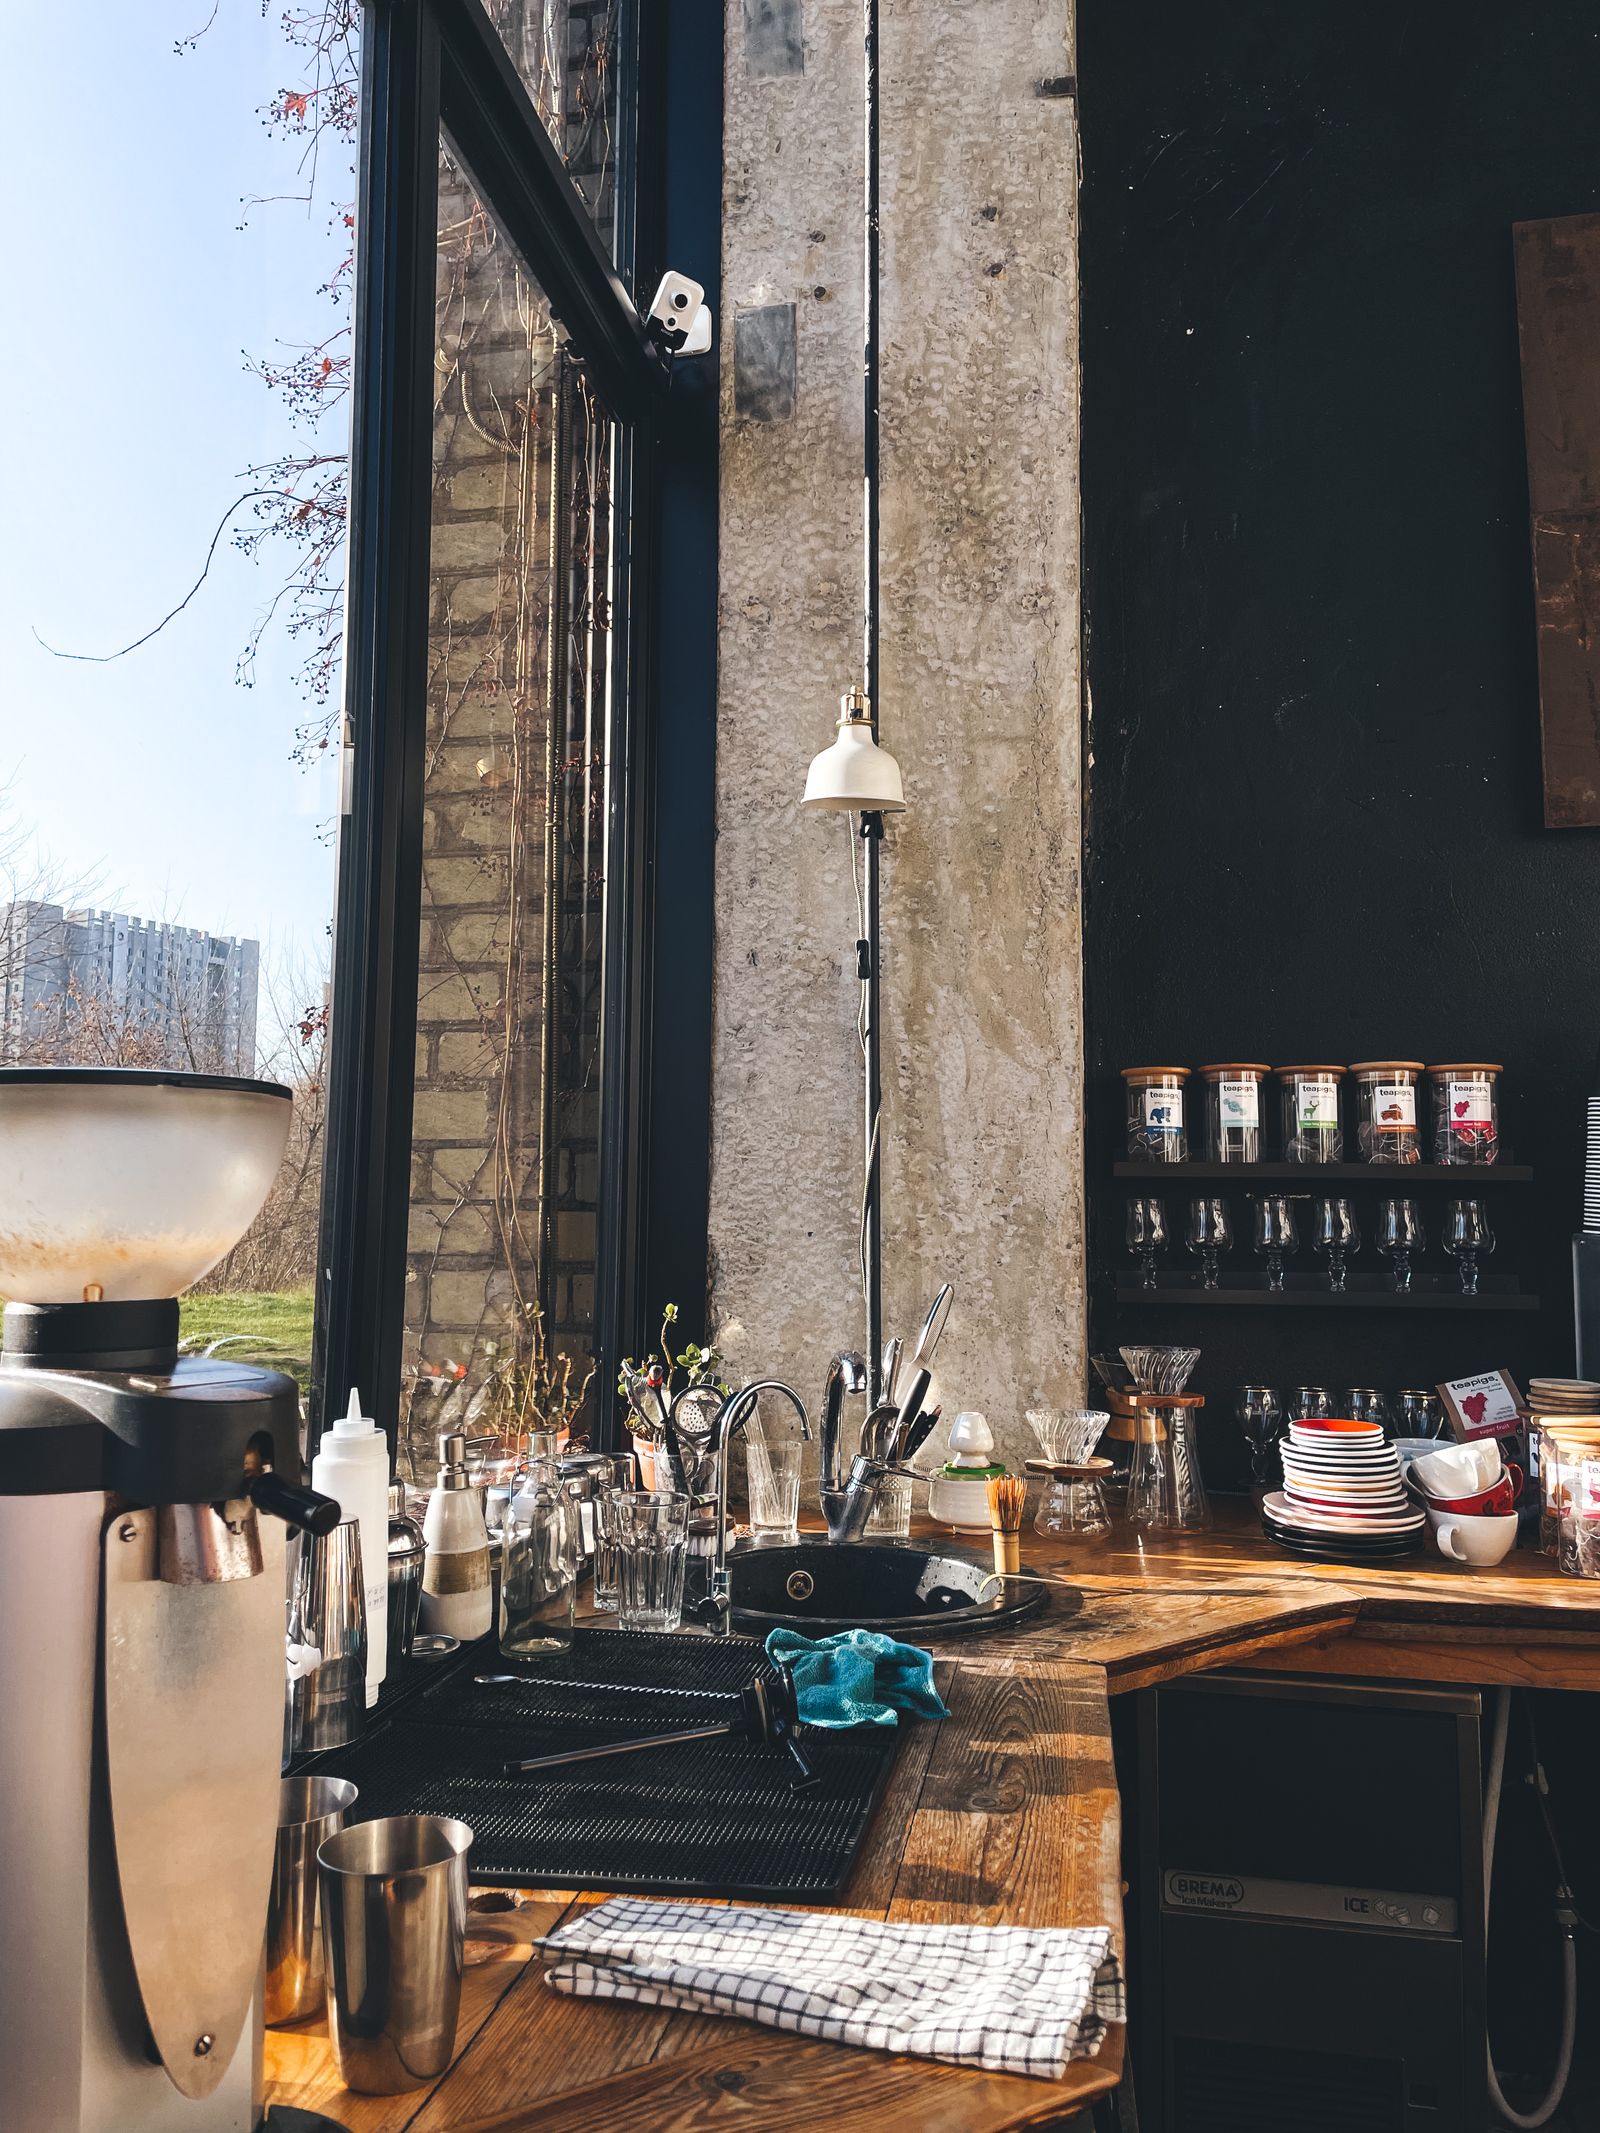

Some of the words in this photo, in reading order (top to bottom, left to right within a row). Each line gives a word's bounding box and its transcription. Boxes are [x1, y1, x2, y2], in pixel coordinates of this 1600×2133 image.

[1451, 1375, 1499, 1391] teapigs.
[1177, 1879, 1237, 1898] BREMA
[1343, 1896, 1370, 1914] ICE
